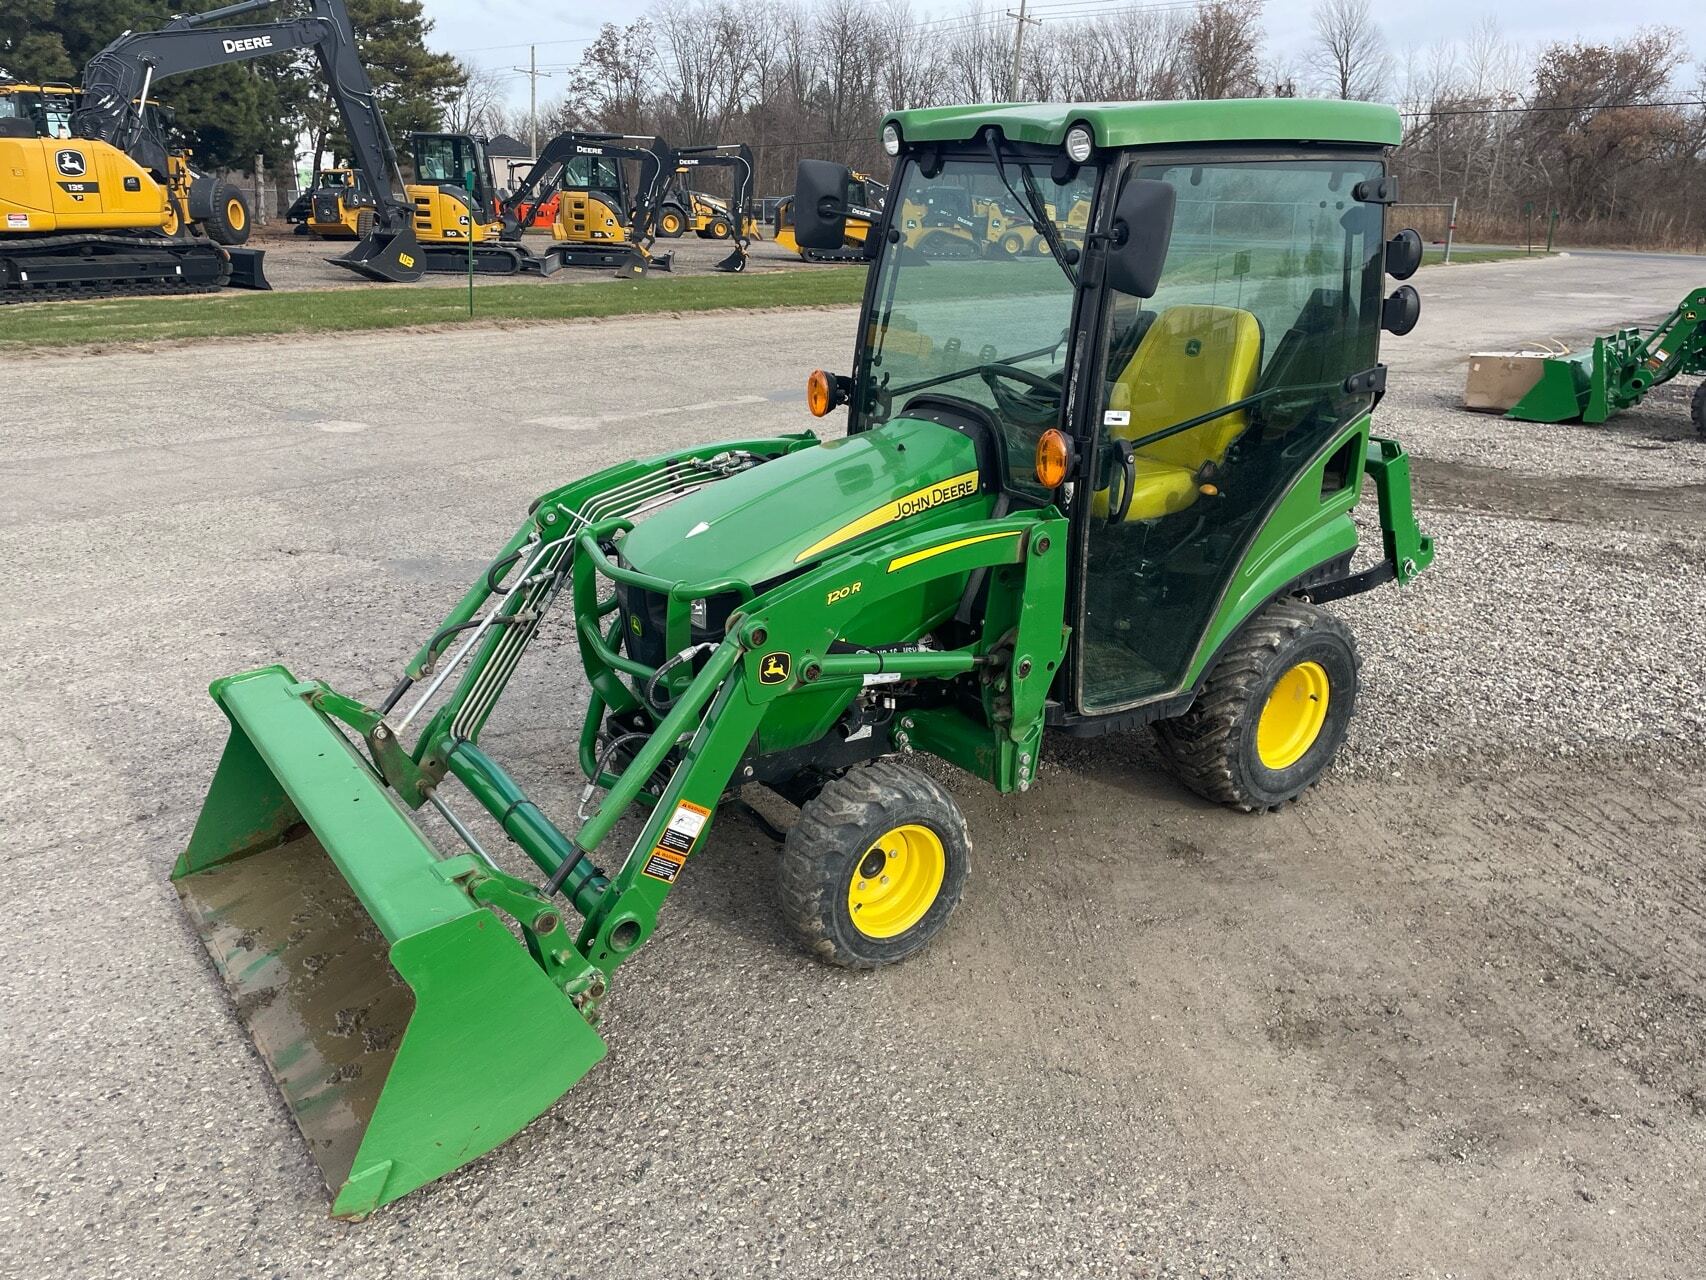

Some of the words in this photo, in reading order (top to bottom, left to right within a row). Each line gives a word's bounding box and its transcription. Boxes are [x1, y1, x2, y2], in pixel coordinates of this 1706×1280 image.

[222, 35, 273, 54] DEERE
[576, 145, 603, 155] DEERE
[67, 183, 84, 192] 135
[851, 207, 871, 217] DEERE
[894, 494, 930, 519] JOHN
[932, 480, 974, 505] DEERE
[827, 586, 851, 606] 120
[851, 581, 862, 595] R
